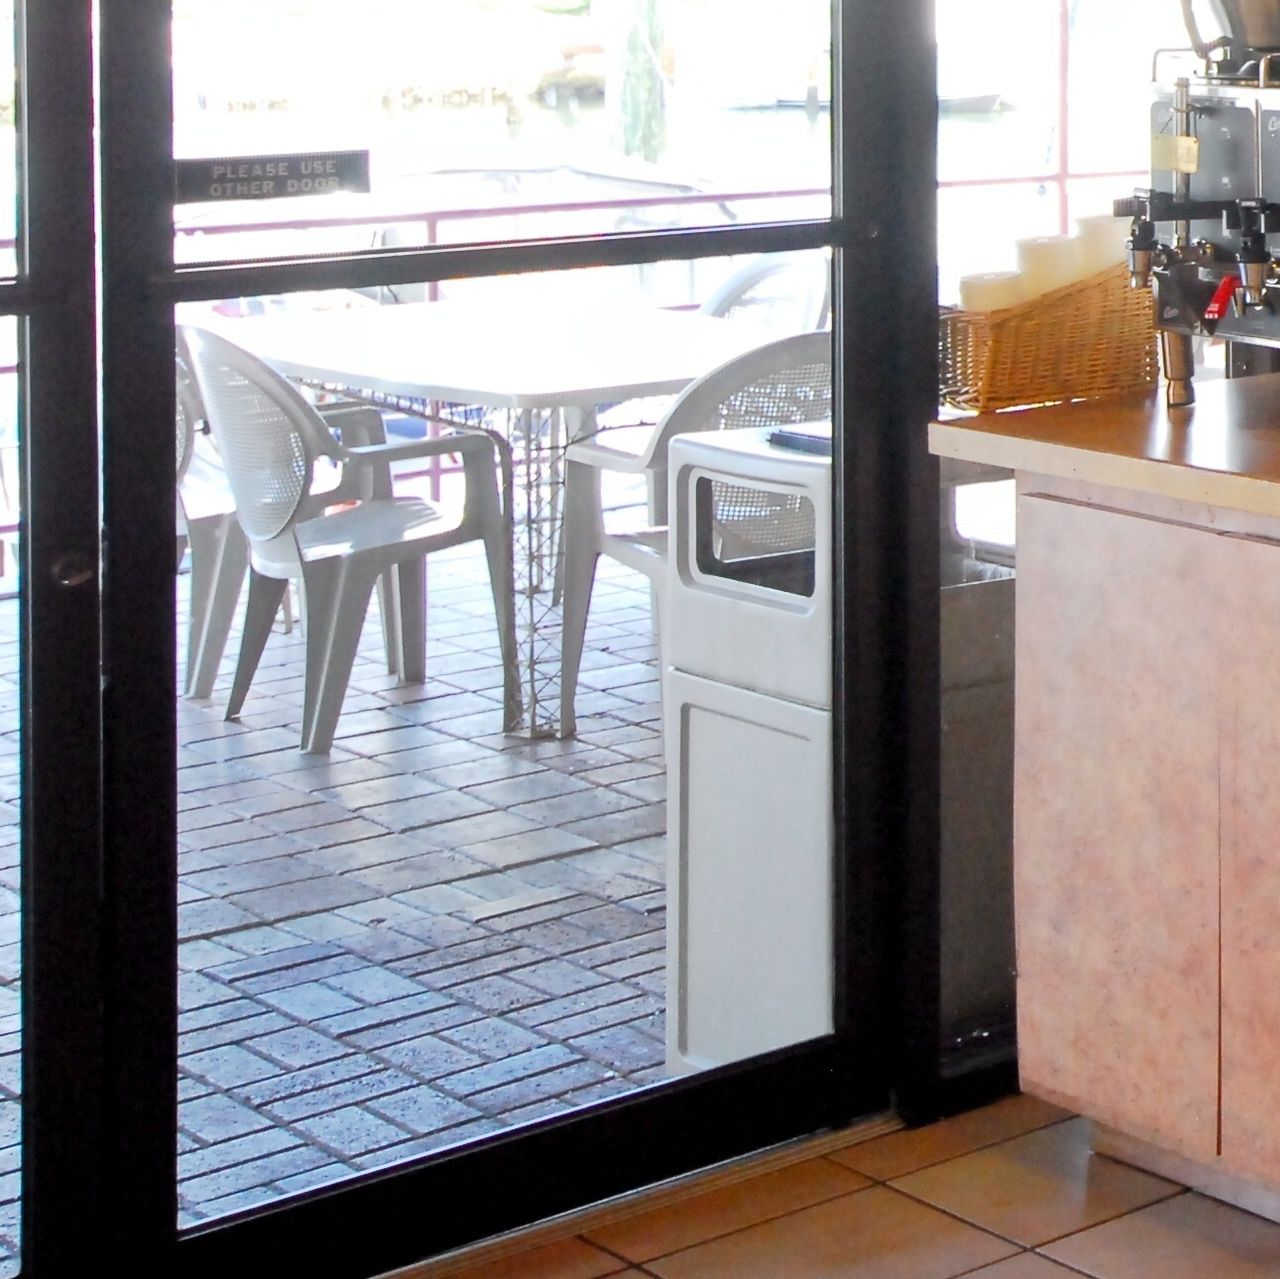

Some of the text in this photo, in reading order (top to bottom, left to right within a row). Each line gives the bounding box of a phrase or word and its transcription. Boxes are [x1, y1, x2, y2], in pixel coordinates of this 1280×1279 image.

[213, 160, 337, 179] PLEASE USE
[210, 176, 340, 197] OTHER DOOR
